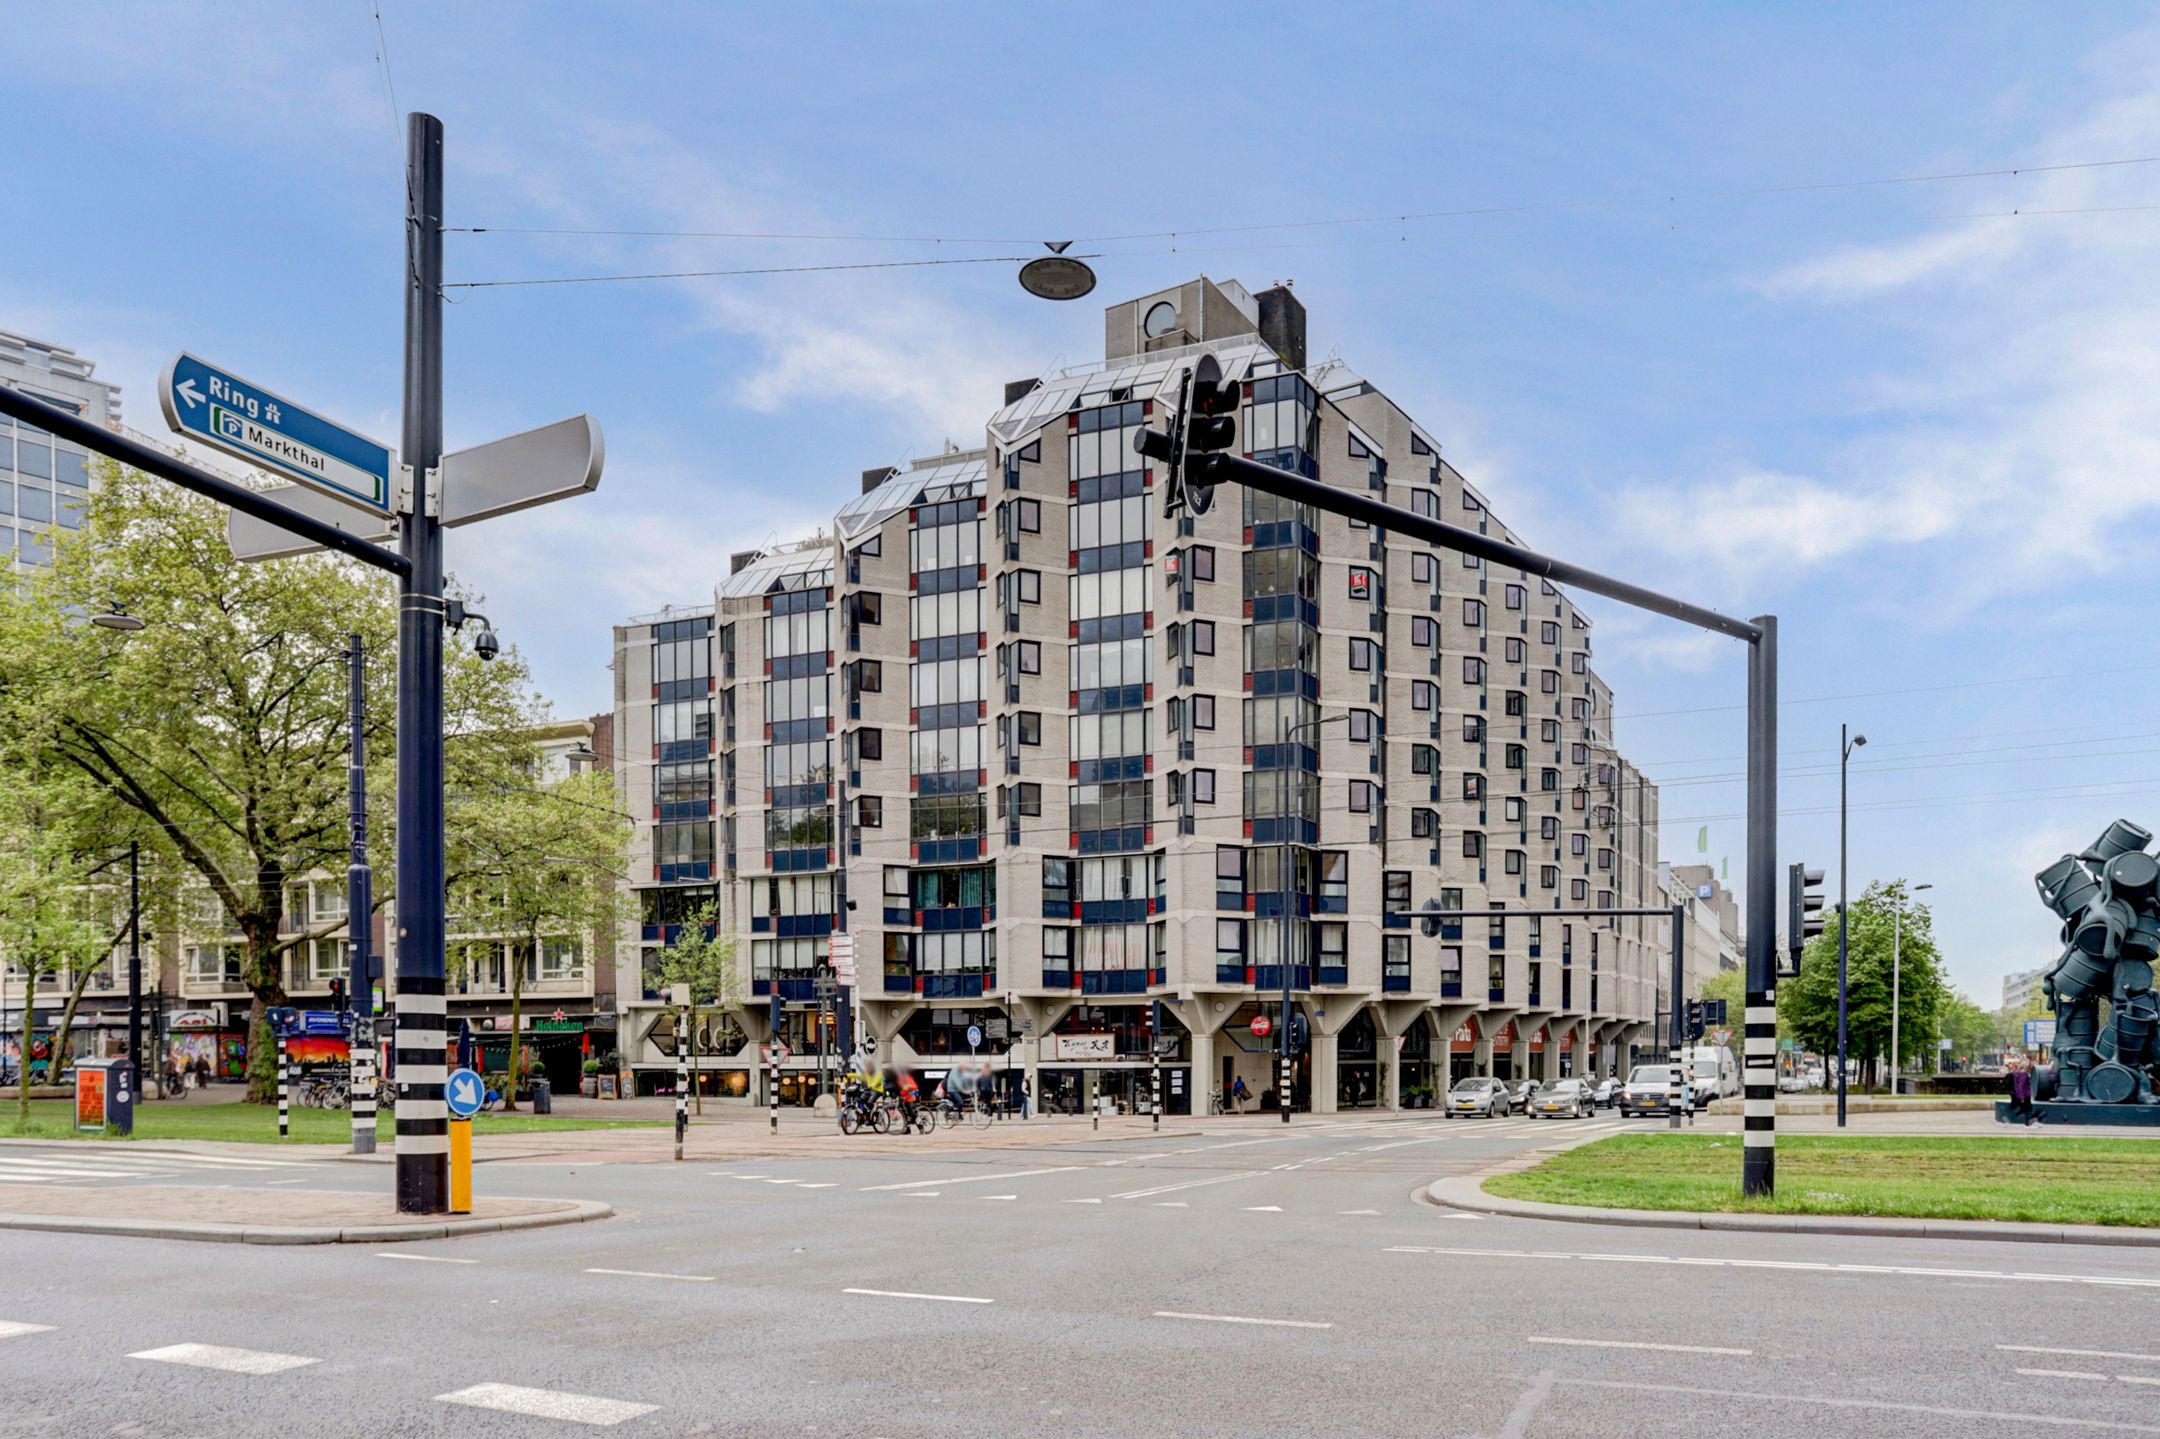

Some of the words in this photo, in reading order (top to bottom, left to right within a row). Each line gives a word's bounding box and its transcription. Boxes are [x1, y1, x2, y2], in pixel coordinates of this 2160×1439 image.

[209, 375, 259, 419] Ring
[248, 426, 325, 471] Markthal
[536, 1019, 583, 1032] Heineken
